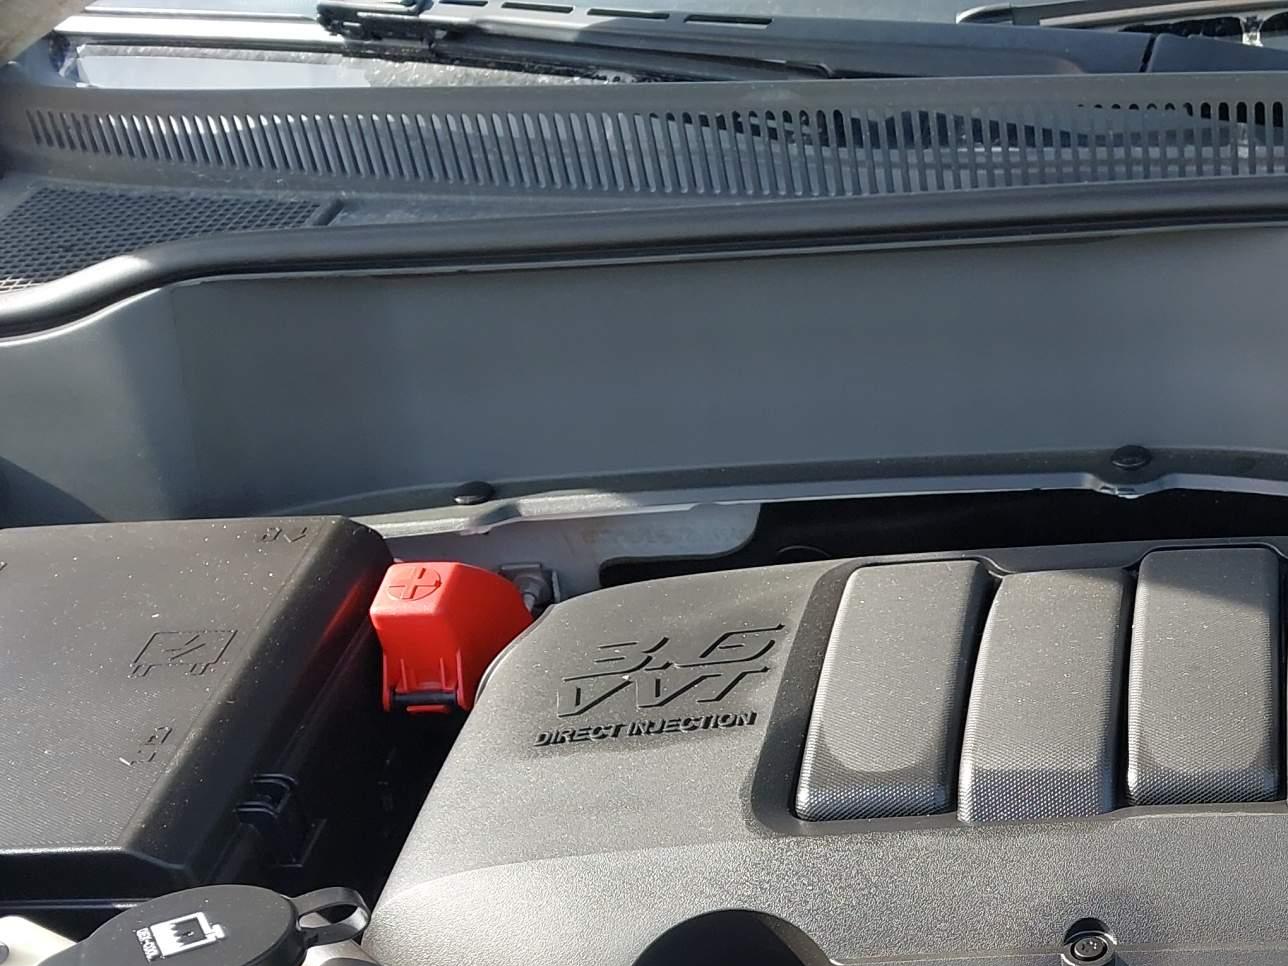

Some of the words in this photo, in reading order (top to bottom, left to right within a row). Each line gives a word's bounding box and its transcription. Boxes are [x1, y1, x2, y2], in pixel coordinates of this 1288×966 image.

[556, 666, 771, 718] VVT
[532, 723, 628, 746] DIRECT
[627, 711, 758, 738] INJECTION
